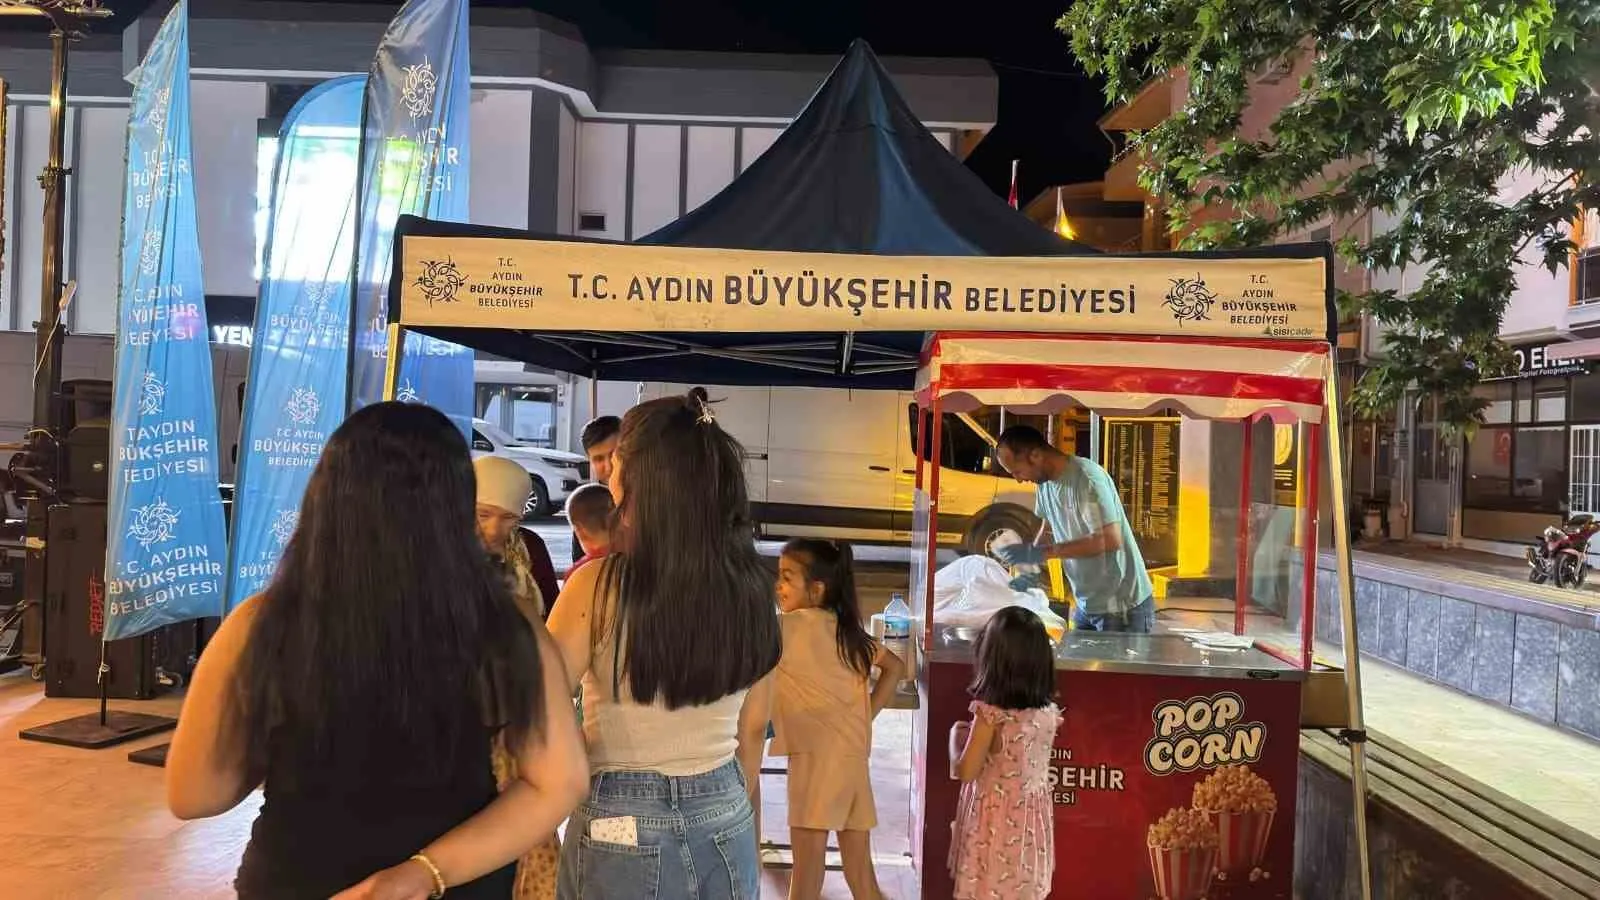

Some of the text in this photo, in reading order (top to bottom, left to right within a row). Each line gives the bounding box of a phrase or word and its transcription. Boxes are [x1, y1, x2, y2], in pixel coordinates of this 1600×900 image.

[498, 257, 517, 267] T.C.
[492, 271, 523, 281] AYDIN
[1250, 274, 1269, 284] T.C.
[470, 282, 543, 297] BÜYÜKŞEHİR
[567, 269, 1136, 316] T.C. AYDIN BÜYÜKŞEHİR BELEDİYESİ
[1242, 289, 1274, 298] AYDIN
[478, 296, 534, 309] BELEDİYESİ
[1222, 300, 1297, 313] BÜYÜKŞEHİR
[1230, 314, 1288, 325] BELEDİYESİ
[151, 544, 208, 568] AYDIN
[110, 579, 218, 617] BELEDİYESİ
[1154, 694, 1244, 740] POP
[1147, 724, 1265, 773] CORN
[1046, 763, 1124, 792] ŞEHİR
